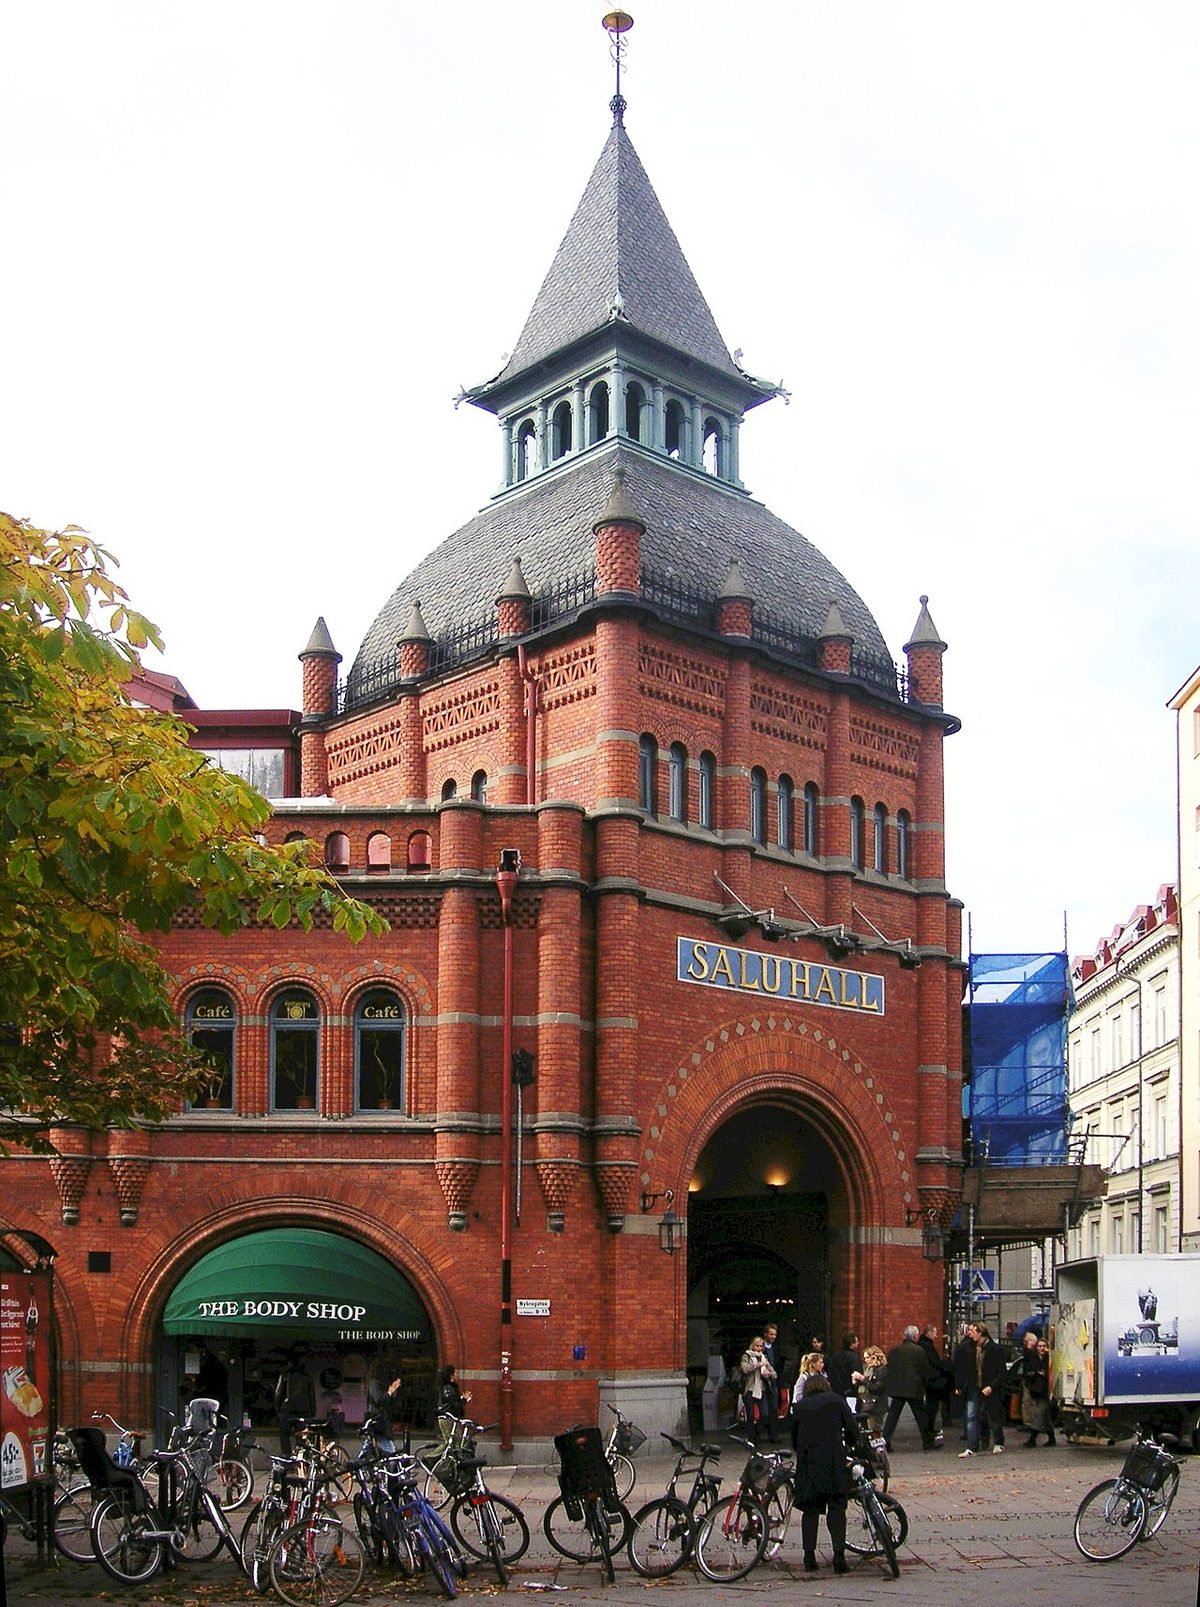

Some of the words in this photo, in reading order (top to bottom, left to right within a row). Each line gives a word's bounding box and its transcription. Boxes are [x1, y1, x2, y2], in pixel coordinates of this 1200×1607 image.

[688, 943, 879, 1011] SALUHALL
[196, 1005, 230, 1018] Café
[364, 1005, 399, 1019] Café
[198, 1301, 239, 1317] THE
[243, 1301, 304, 1317] BODY
[306, 1302, 366, 1321] SHOP
[338, 1330, 364, 1340] THE
[366, 1330, 395, 1340] BODY
[397, 1330, 421, 1340] SHOP
